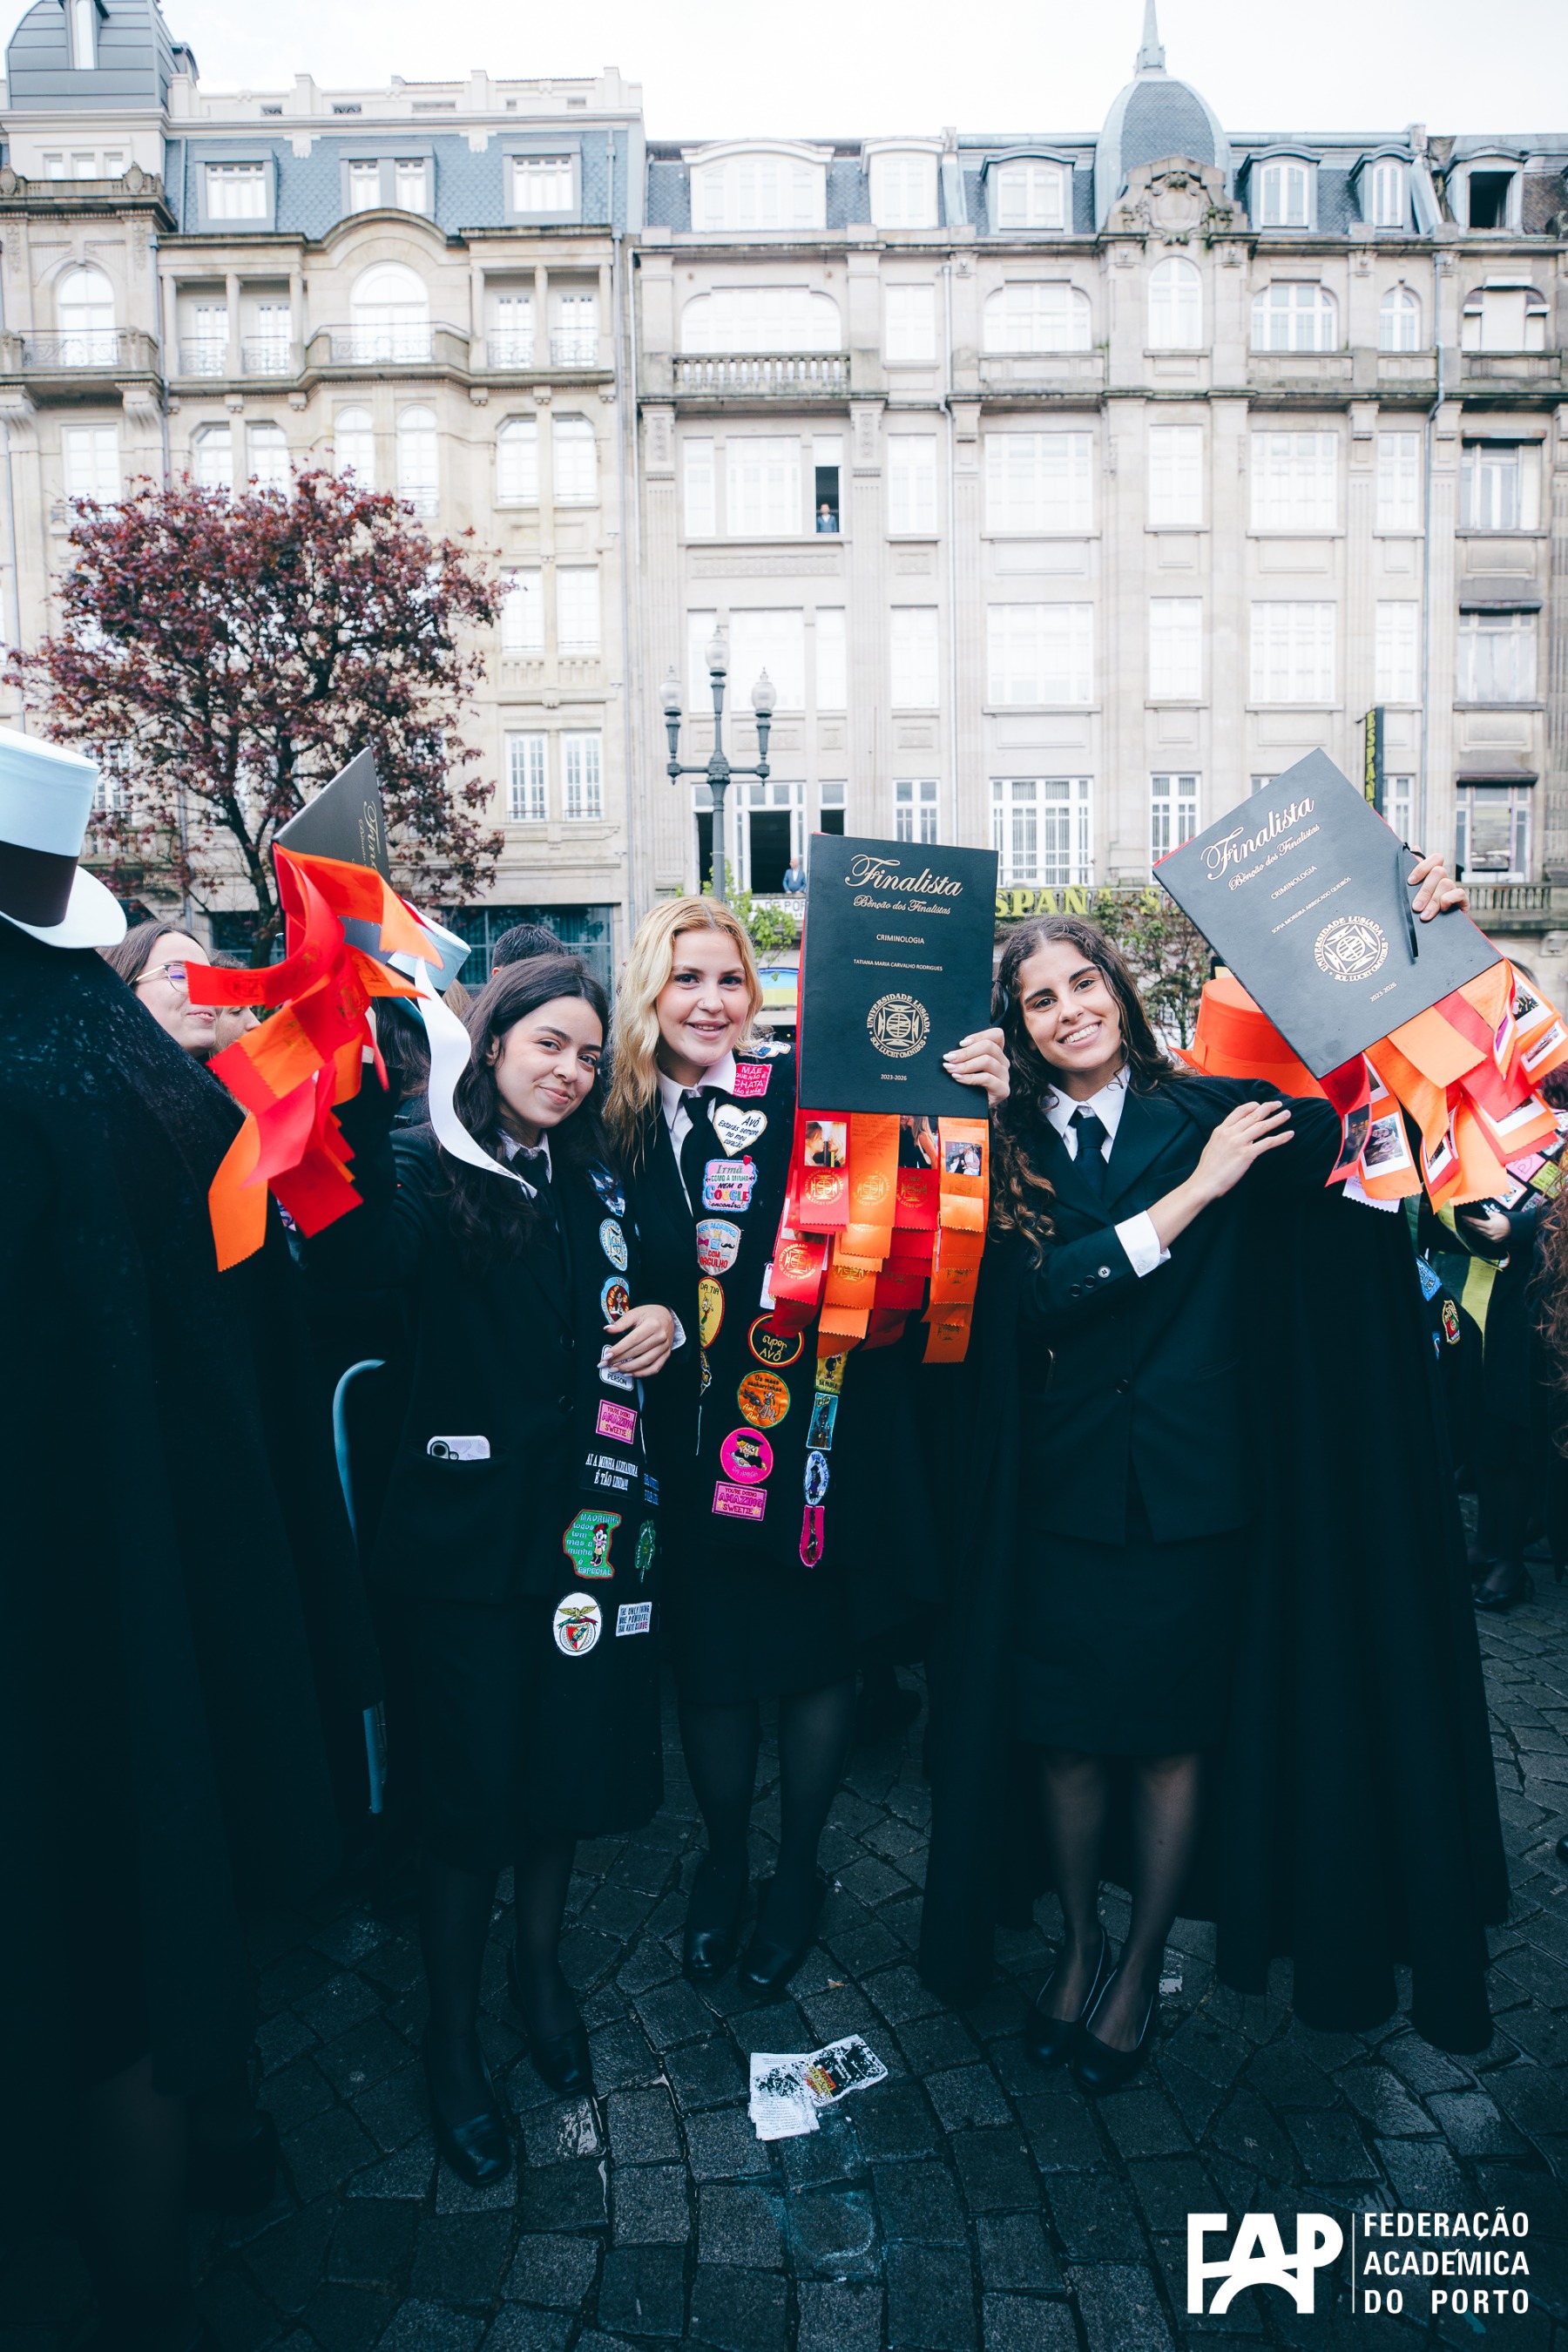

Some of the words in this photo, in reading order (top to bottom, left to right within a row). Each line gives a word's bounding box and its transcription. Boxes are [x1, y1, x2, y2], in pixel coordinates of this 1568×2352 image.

[1200, 796, 1315, 880] Finalista
[1228, 864, 1264, 891] Bênção
[1265, 854, 1278, 867] dos
[1277, 823, 1321, 856] Finalistas
[845, 854, 963, 896] Finalista
[1271, 865, 1318, 900] CRIMINOLOGIA
[854, 895, 891, 909] Bênção
[892, 901, 907, 911] dos
[908, 899, 951, 915] Finalistas
[1271, 922, 1285, 935] SOFIA
[1284, 908, 1307, 925] MOREIRA
[1306, 890, 1331, 910] ARRISCADO
[876, 934, 924, 944] CRIMINOLOGIA
[1315, 917, 1346, 972] UNIVERSIDADE
[1348, 970, 1373, 982] LUCET
[1369, 982, 1397, 1003] 2023-2026
[867, 993, 913, 1029] UNIVERSIDADE
[870, 1037, 880, 1050] SOL
[878, 1046, 900, 1058] LUCET
[899, 1039, 926, 1058] OMNIBUS
[741, 1065, 763, 1075] MÃE
[735, 1079, 763, 1089] CHATA
[718, 1119, 740, 1132] Estarás
[740, 1127, 760, 1136] sempre
[741, 1116, 761, 1128] Avô
[724, 1139, 744, 1149] coração
[733, 1133, 747, 1142] meu
[717, 1165, 743, 1174] Irmã
[706, 1184, 750, 1202] GOOGLE
[711, 1200, 742, 1209] encontra
[700, 1255, 729, 1268] ORGULHO
[700, 1282, 708, 1291] DA
[710, 1286, 720, 1295] TIA
[760, 1348, 782, 1362] AVÔ
[607, 1374, 627, 1385] PERSON
[602, 1412, 634, 1429] AMAZING
[605, 1424, 627, 1437] SWEETIE
[592, 1455, 598, 1467] A
[719, 1492, 763, 1507] AMAZING
[723, 1504, 754, 1515] SWEETIE
[580, 1514, 620, 1524] MADRINHA
[573, 1522, 594, 1531] todos
[578, 1566, 612, 1576] ESPECIAL
